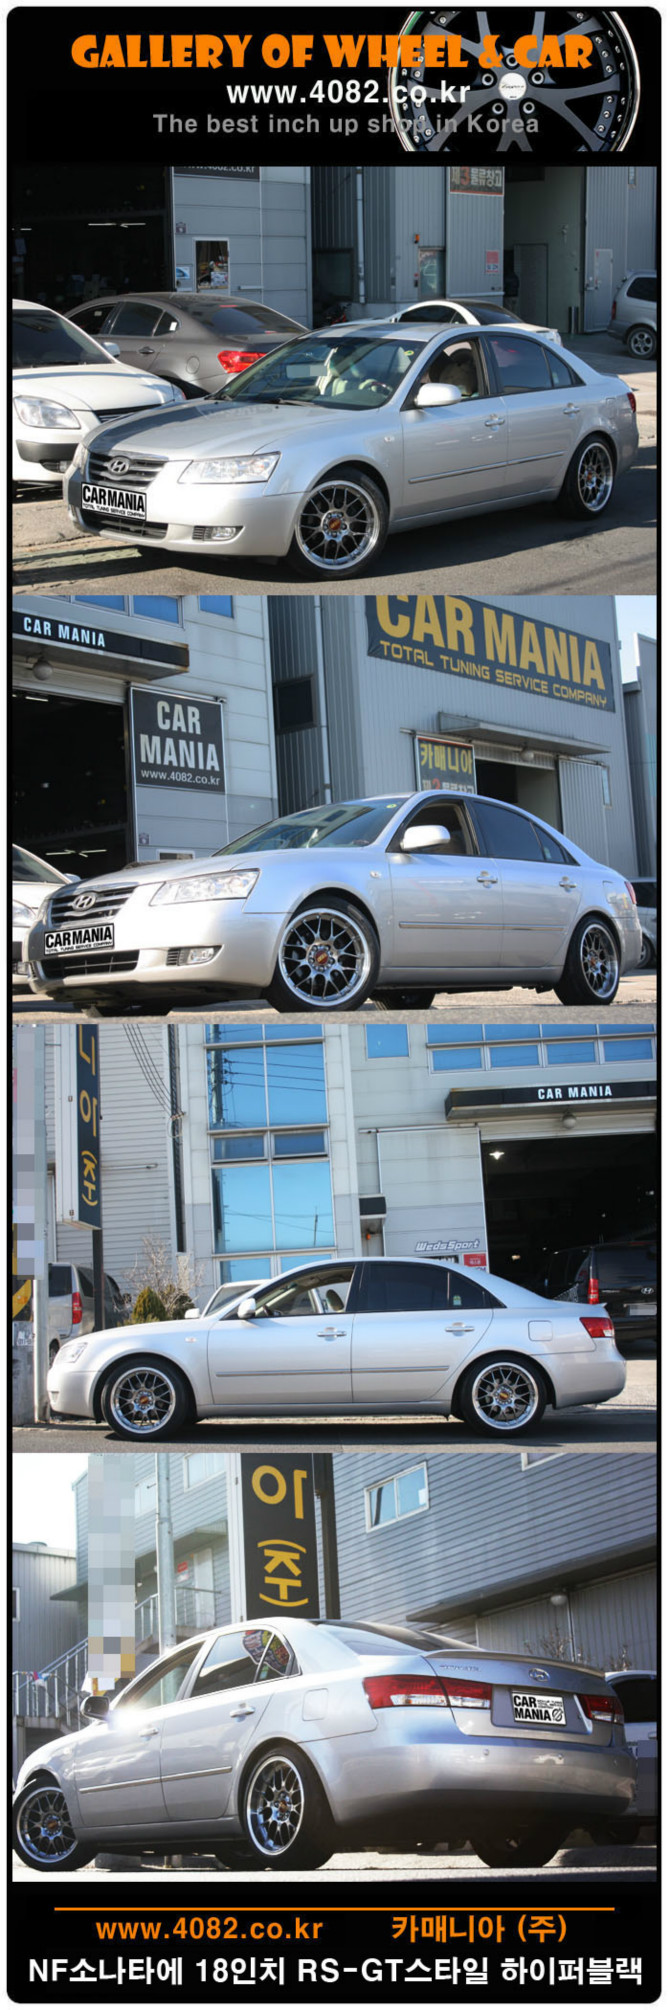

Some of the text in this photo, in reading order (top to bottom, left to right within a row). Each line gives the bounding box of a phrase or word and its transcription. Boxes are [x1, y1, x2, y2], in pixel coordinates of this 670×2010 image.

[23, 616, 106, 648] CAR MANIA
[377, 595, 606, 691] CAR MANIA
[380, 640, 608, 708] TOTAL TUNING SERVICE COMPANY
[157, 700, 202, 736] CAR
[140, 733, 220, 772] MANIA
[140, 769, 221, 786] www.4082.co.kr
[537, 1085, 613, 1100] CAR MANIA
[513, 1695, 537, 1708] CAR
[514, 1707, 552, 1722] MANIA
